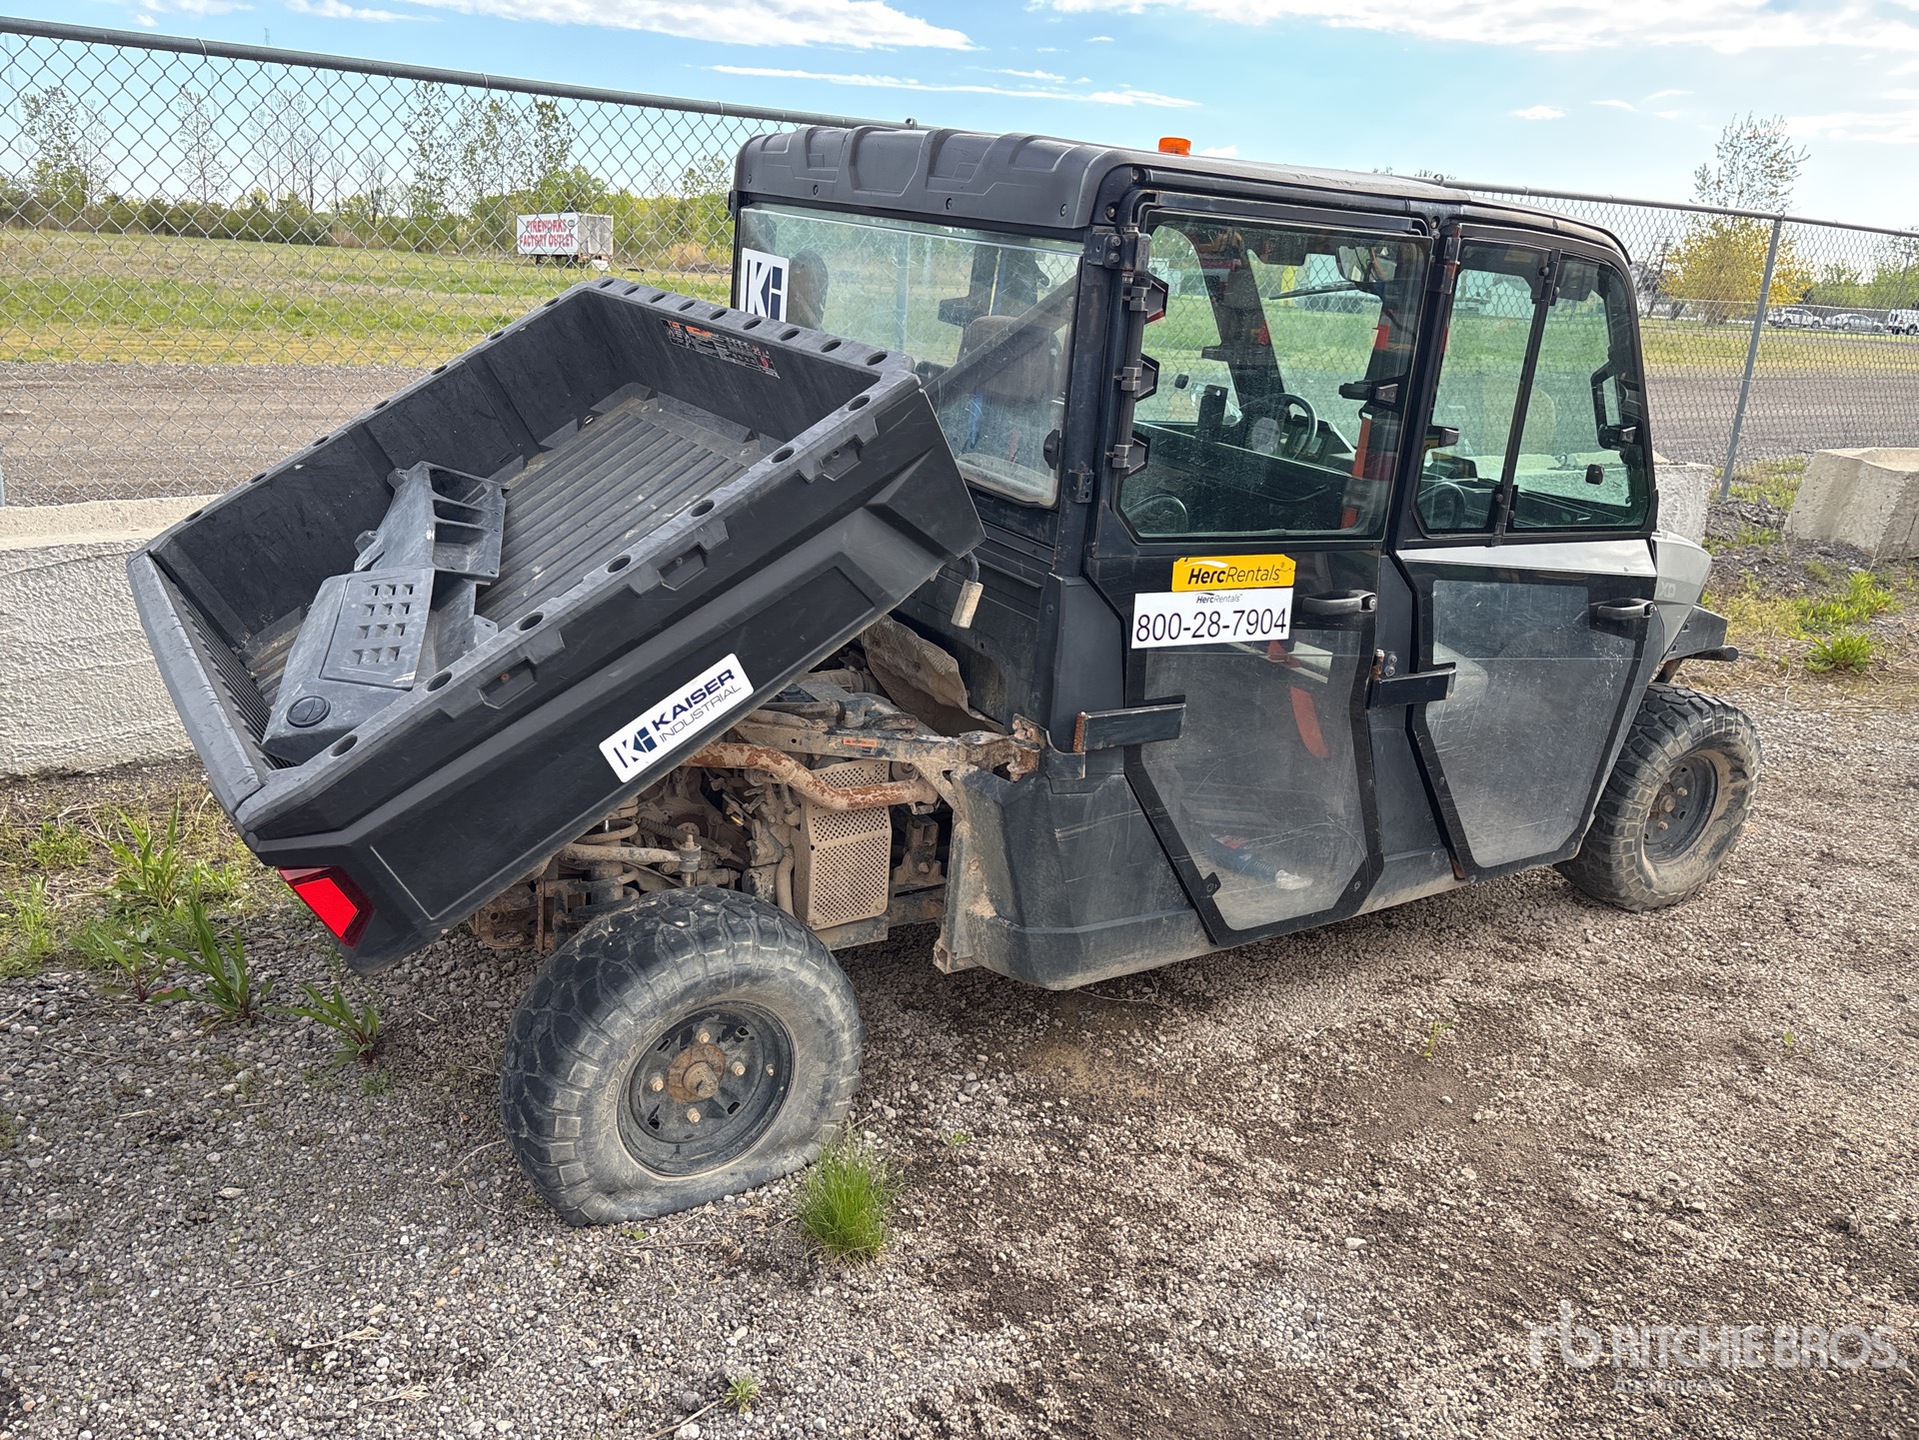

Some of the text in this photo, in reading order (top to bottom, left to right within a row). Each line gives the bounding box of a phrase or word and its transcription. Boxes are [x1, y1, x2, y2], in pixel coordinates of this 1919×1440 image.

[520, 233, 573, 247] FACTORY OUTLET
[1135, 607, 1287, 642] 800-28-7904
[651, 668, 736, 731] KAISER
[659, 685, 742, 743] INDUSTRIAL
